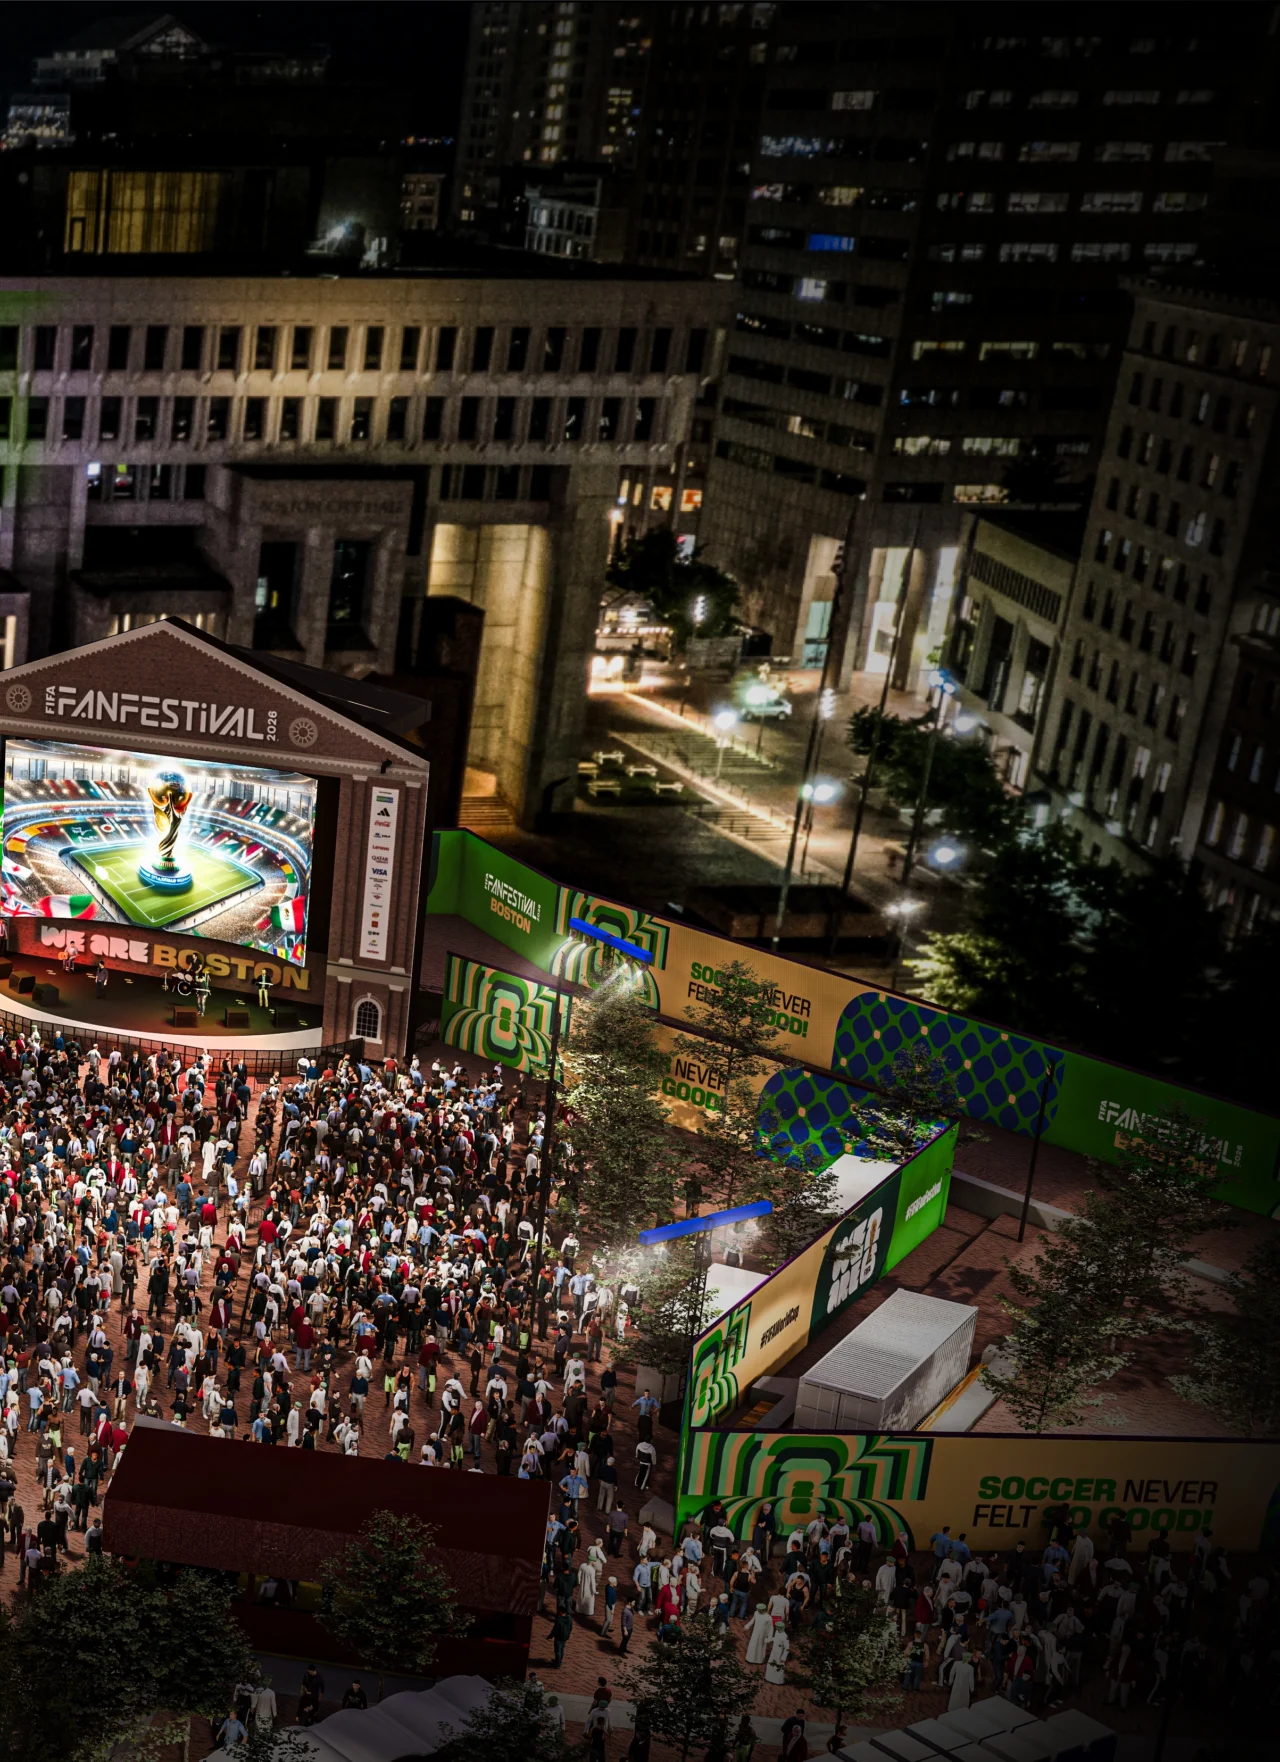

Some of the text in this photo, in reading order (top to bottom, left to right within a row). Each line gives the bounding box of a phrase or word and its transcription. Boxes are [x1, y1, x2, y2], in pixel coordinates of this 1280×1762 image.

[45, 685, 56, 715] FIFA
[267, 710, 278, 742] 2026
[371, 868, 387, 876] VISA
[490, 897, 531, 934] BOSTON
[40, 925, 311, 991] WE ARE BOSTON
[751, 1002, 809, 1038] OOD!
[661, 1077, 722, 1112] GOOD
[1098, 1100, 1108, 1121] FIFA
[1233, 1144, 1243, 1168] 2026
[977, 1476, 1219, 1504] SOCCER NEVER
[972, 1504, 1214, 1532] FELT SO GOOD!
